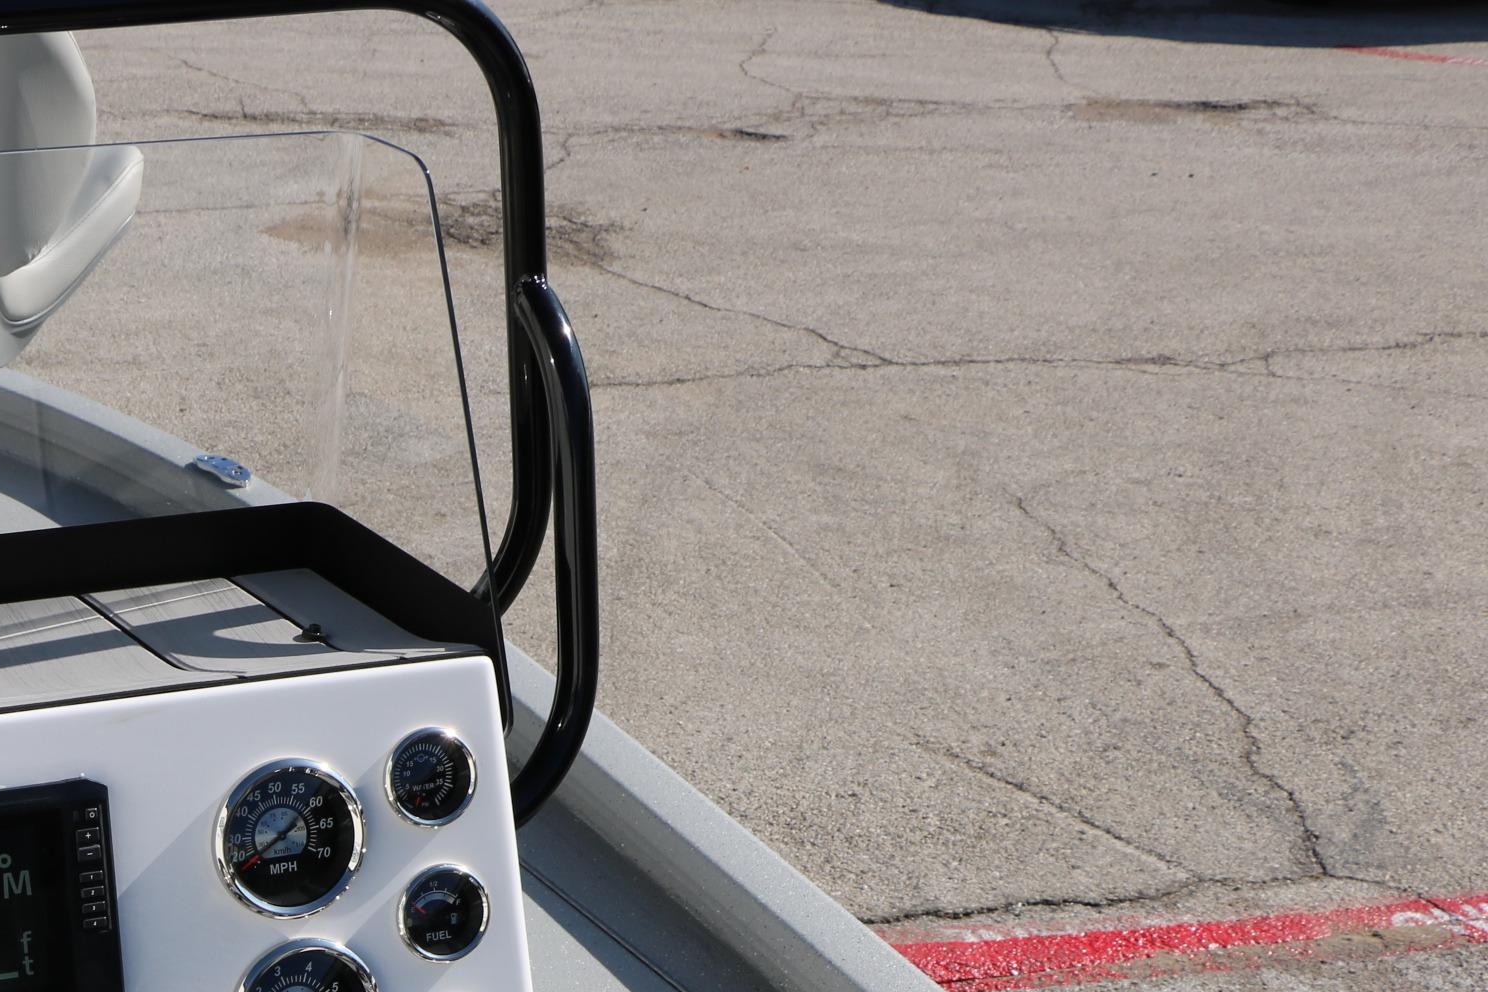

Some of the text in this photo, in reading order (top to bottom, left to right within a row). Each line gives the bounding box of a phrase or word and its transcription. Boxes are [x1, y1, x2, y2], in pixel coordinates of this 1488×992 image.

[268, 782, 281, 793] 50
[292, 783, 305, 794] 55
[310, 796, 322, 807] 60
[320, 818, 333, 829] 65
[318, 847, 330, 859] 70
[270, 861, 297, 875] MPH
[426, 930, 452, 942] FUEL
[274, 966, 280, 976] 3
[306, 961, 312, 972] 4
[332, 982, 339, 992] 5
